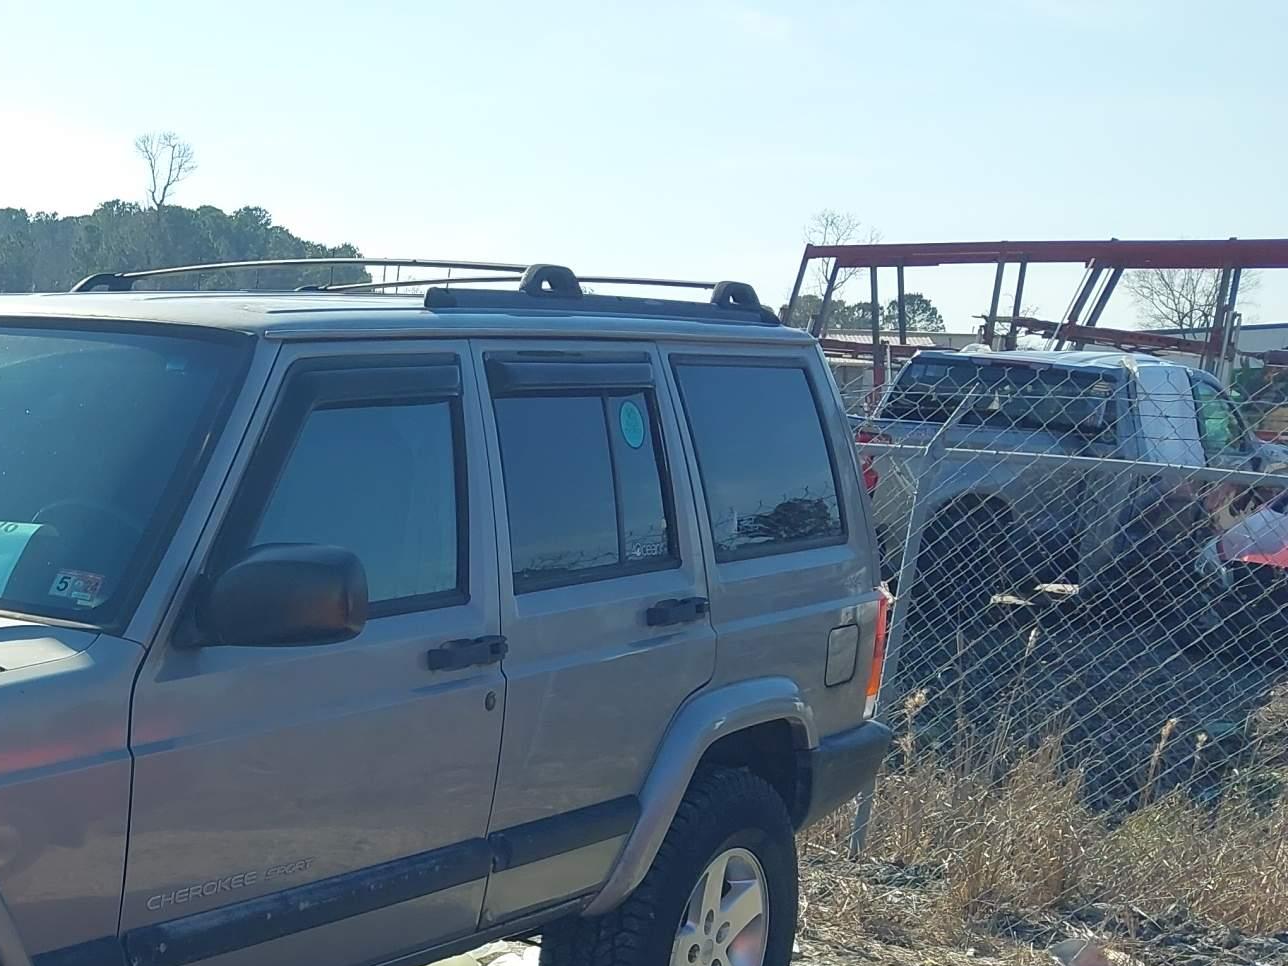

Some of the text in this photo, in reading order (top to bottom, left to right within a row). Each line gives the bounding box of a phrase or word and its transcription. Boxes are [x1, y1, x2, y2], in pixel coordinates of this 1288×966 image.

[56, 575, 72, 592] 5
[146, 857, 316, 911] CHEROKEE SPORT
